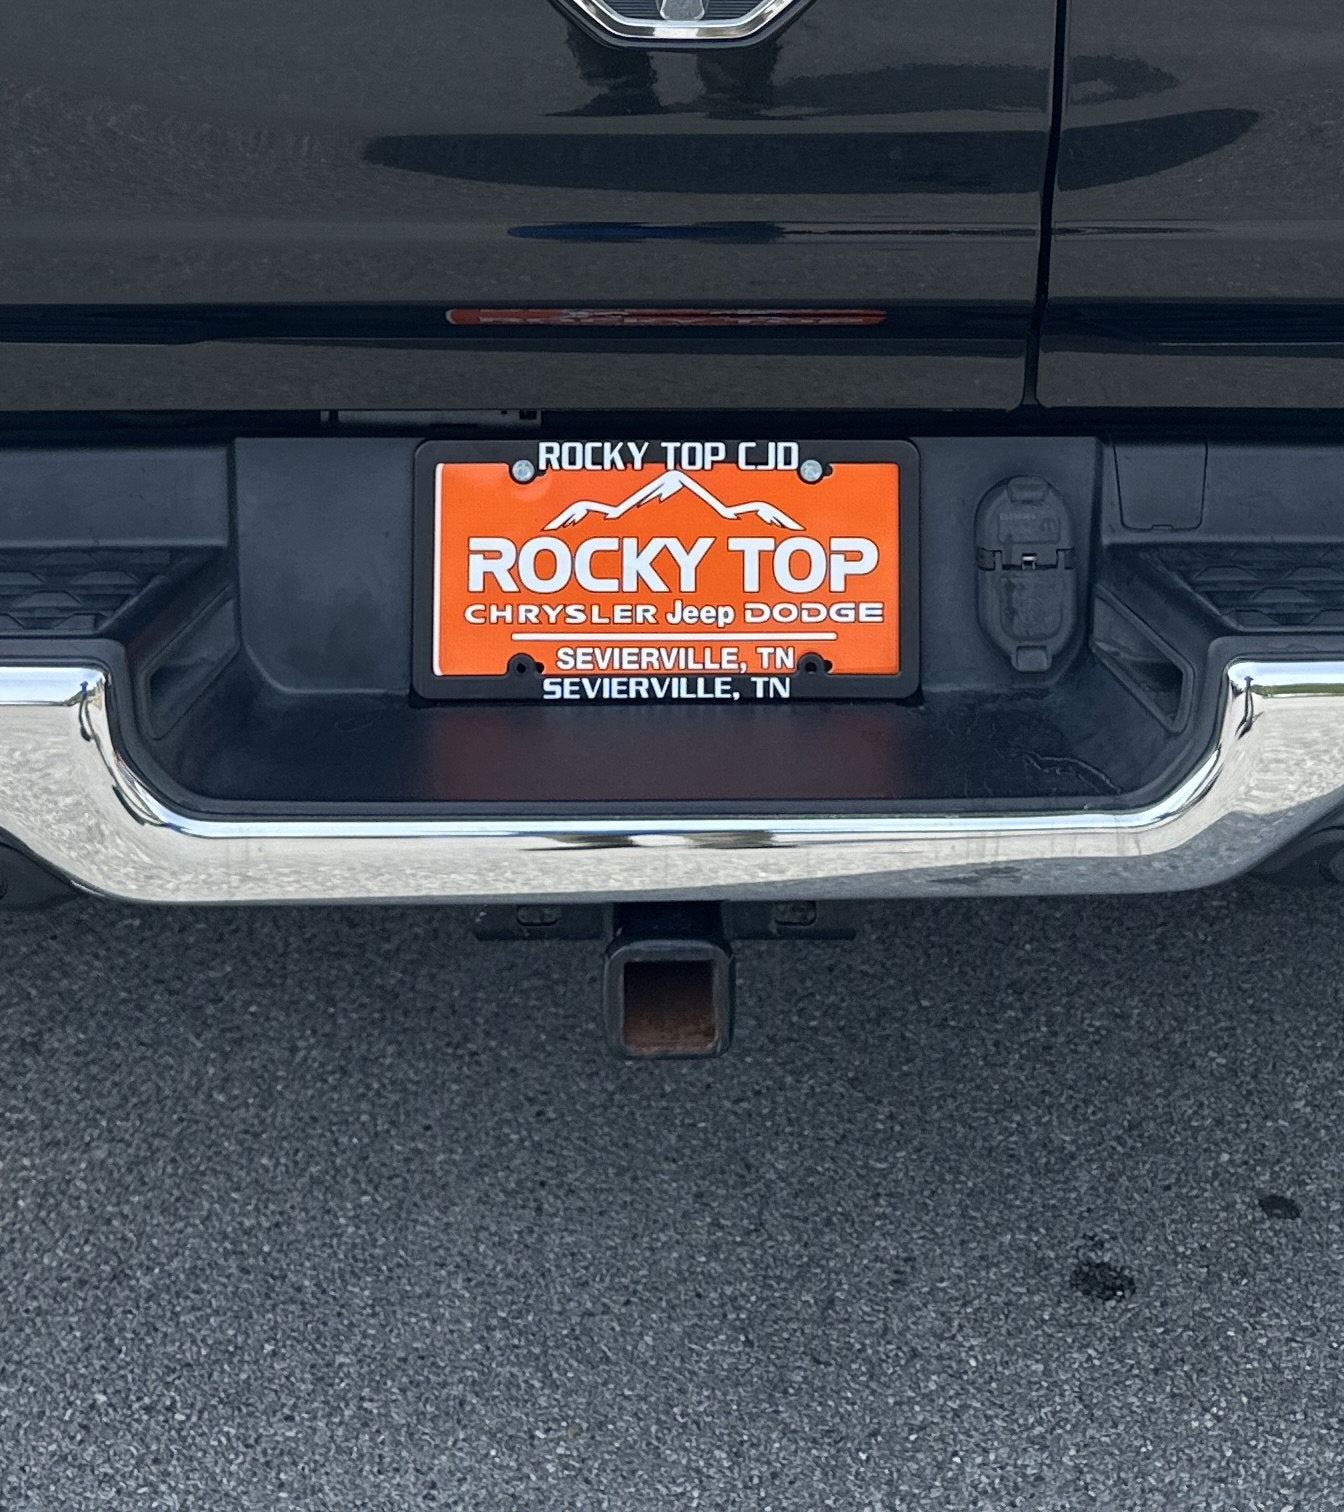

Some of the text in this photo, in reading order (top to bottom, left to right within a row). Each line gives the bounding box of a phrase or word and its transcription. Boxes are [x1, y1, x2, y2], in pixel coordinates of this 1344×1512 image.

[538, 442, 800, 471] ROCKY TOP CJD
[467, 536, 880, 593] ROCKY TOP
[464, 600, 884, 628] CHRYSLER Jeep DODGE
[556, 647, 796, 673] SEVIERVILLE, TN
[542, 676, 792, 702] SEVIERVILLE, TN
